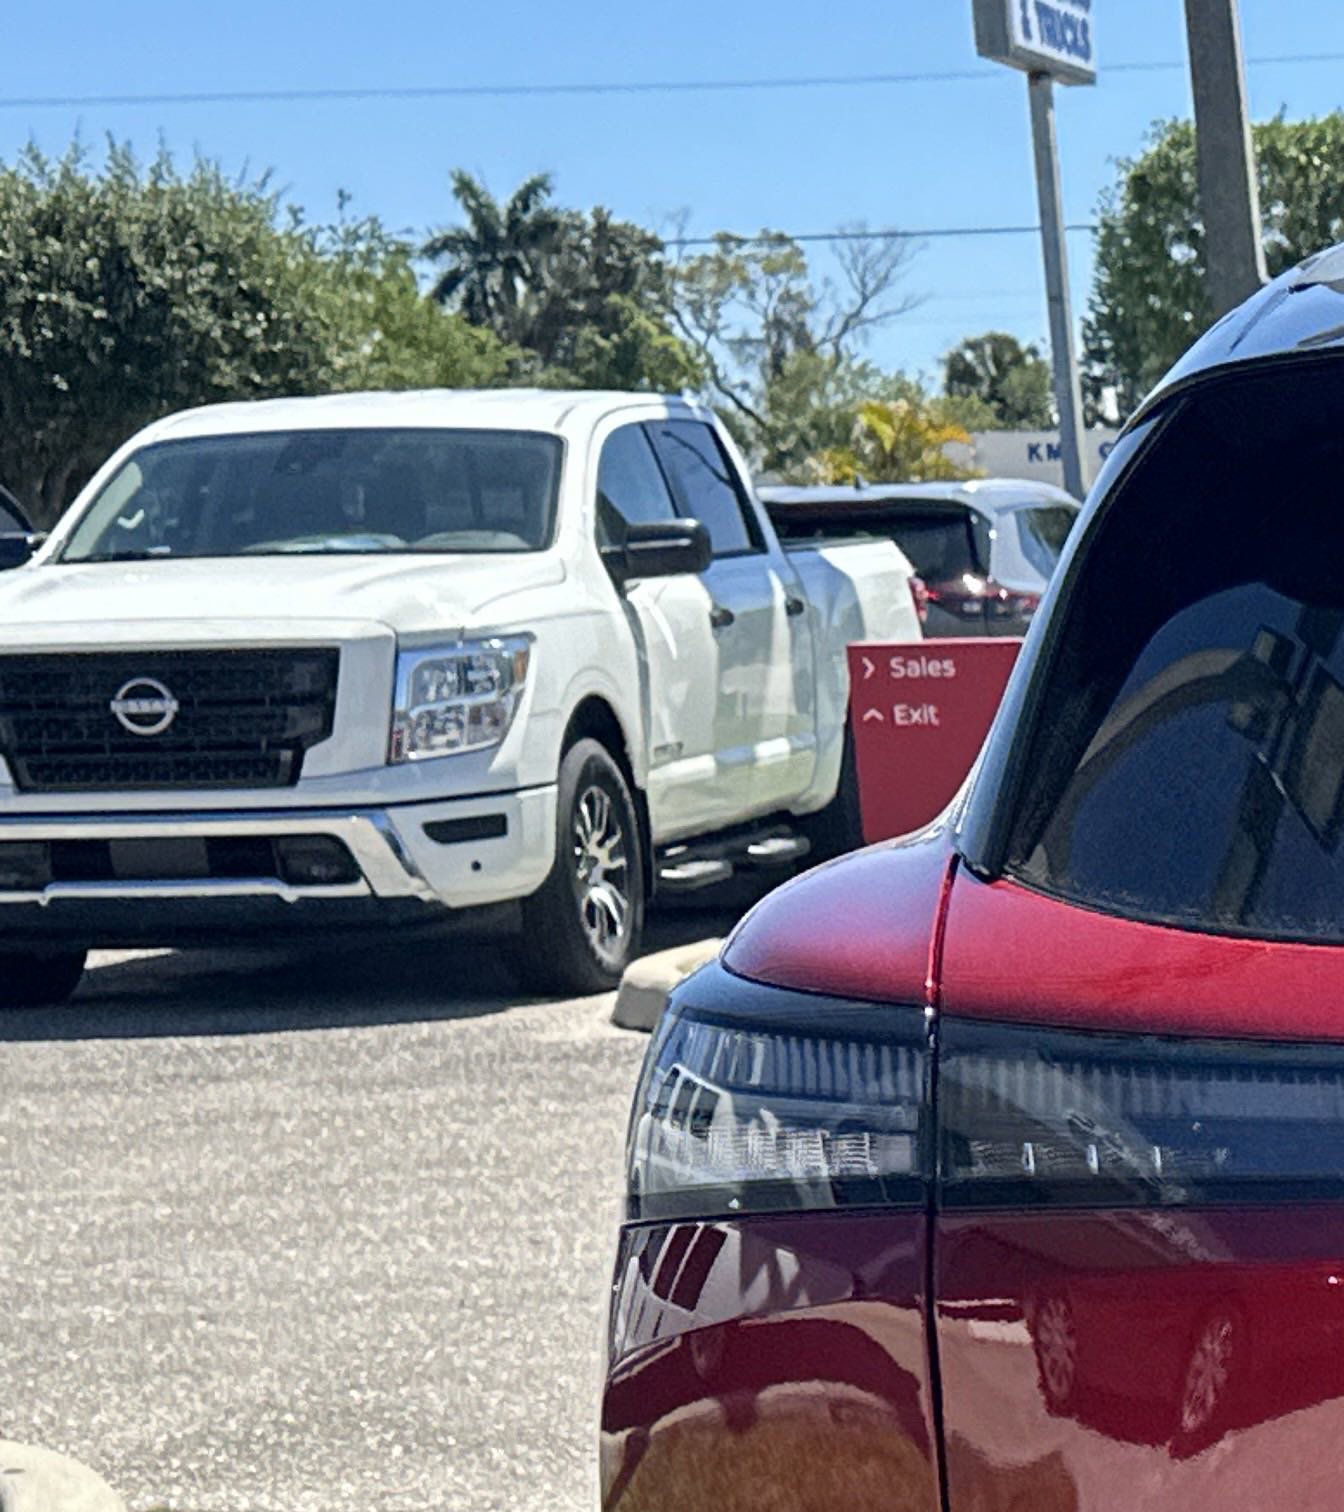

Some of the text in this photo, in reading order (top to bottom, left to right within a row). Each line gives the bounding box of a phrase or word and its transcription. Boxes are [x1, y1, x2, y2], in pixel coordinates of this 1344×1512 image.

[1035, 0, 1092, 62] TRUCKS
[889, 655, 956, 678] Sales
[893, 703, 940, 726] Exit
